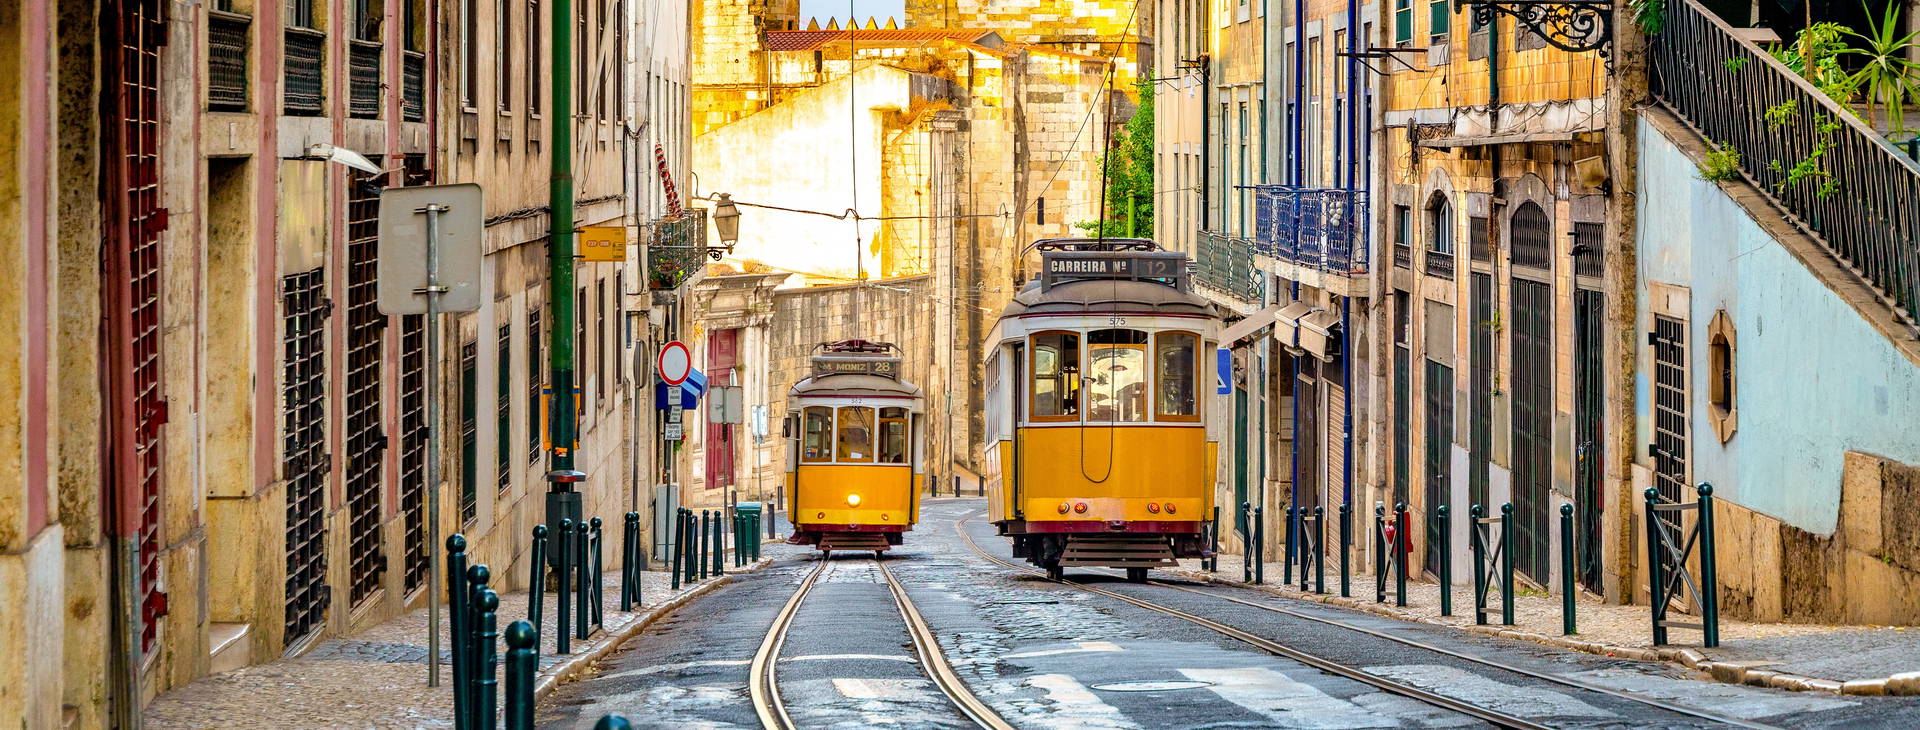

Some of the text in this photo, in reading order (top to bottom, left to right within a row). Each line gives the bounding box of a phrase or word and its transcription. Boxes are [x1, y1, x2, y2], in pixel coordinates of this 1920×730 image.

[1051, 260, 1106, 273] CARREIRA
[1145, 261, 1166, 276] 12
[1109, 317, 1126, 326] 575
[836, 363, 866, 371] MONIZ
[875, 362, 890, 372] 28
